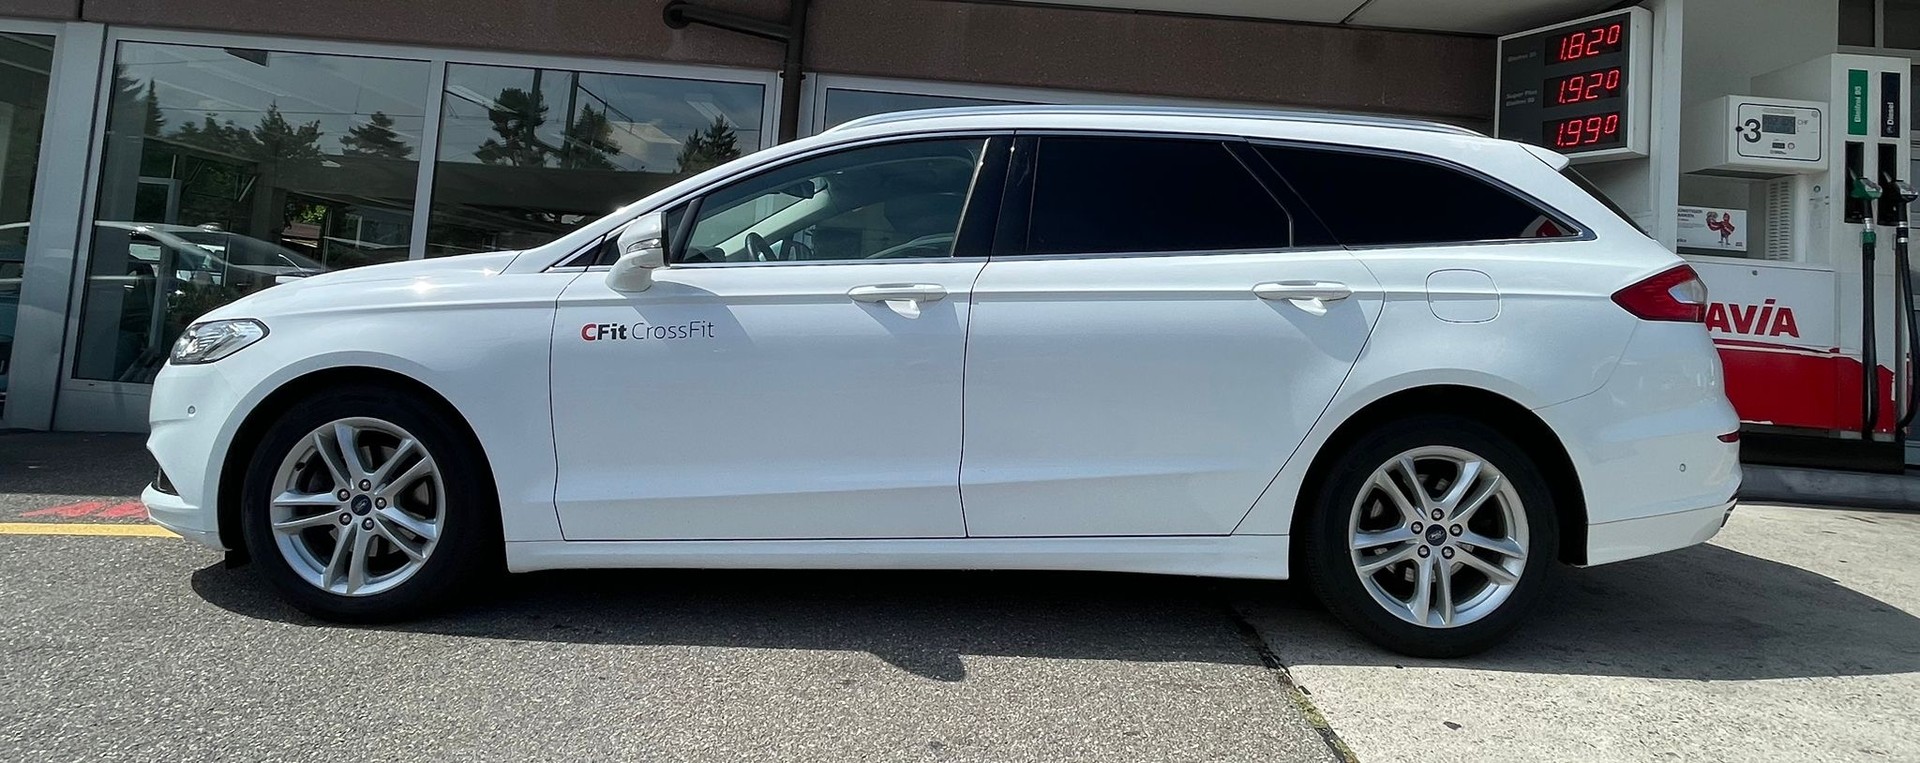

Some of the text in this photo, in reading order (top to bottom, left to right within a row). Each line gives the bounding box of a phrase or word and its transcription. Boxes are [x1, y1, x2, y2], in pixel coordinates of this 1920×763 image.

[1559, 24, 1621, 61] 1.820
[1558, 69, 1620, 104] 1.920
[1886, 101, 1894, 126] Diesel
[1557, 114, 1619, 147] 1.990
[1743, 118, 1762, 143] 3
[581, 320, 715, 342] CFit CrossFit
